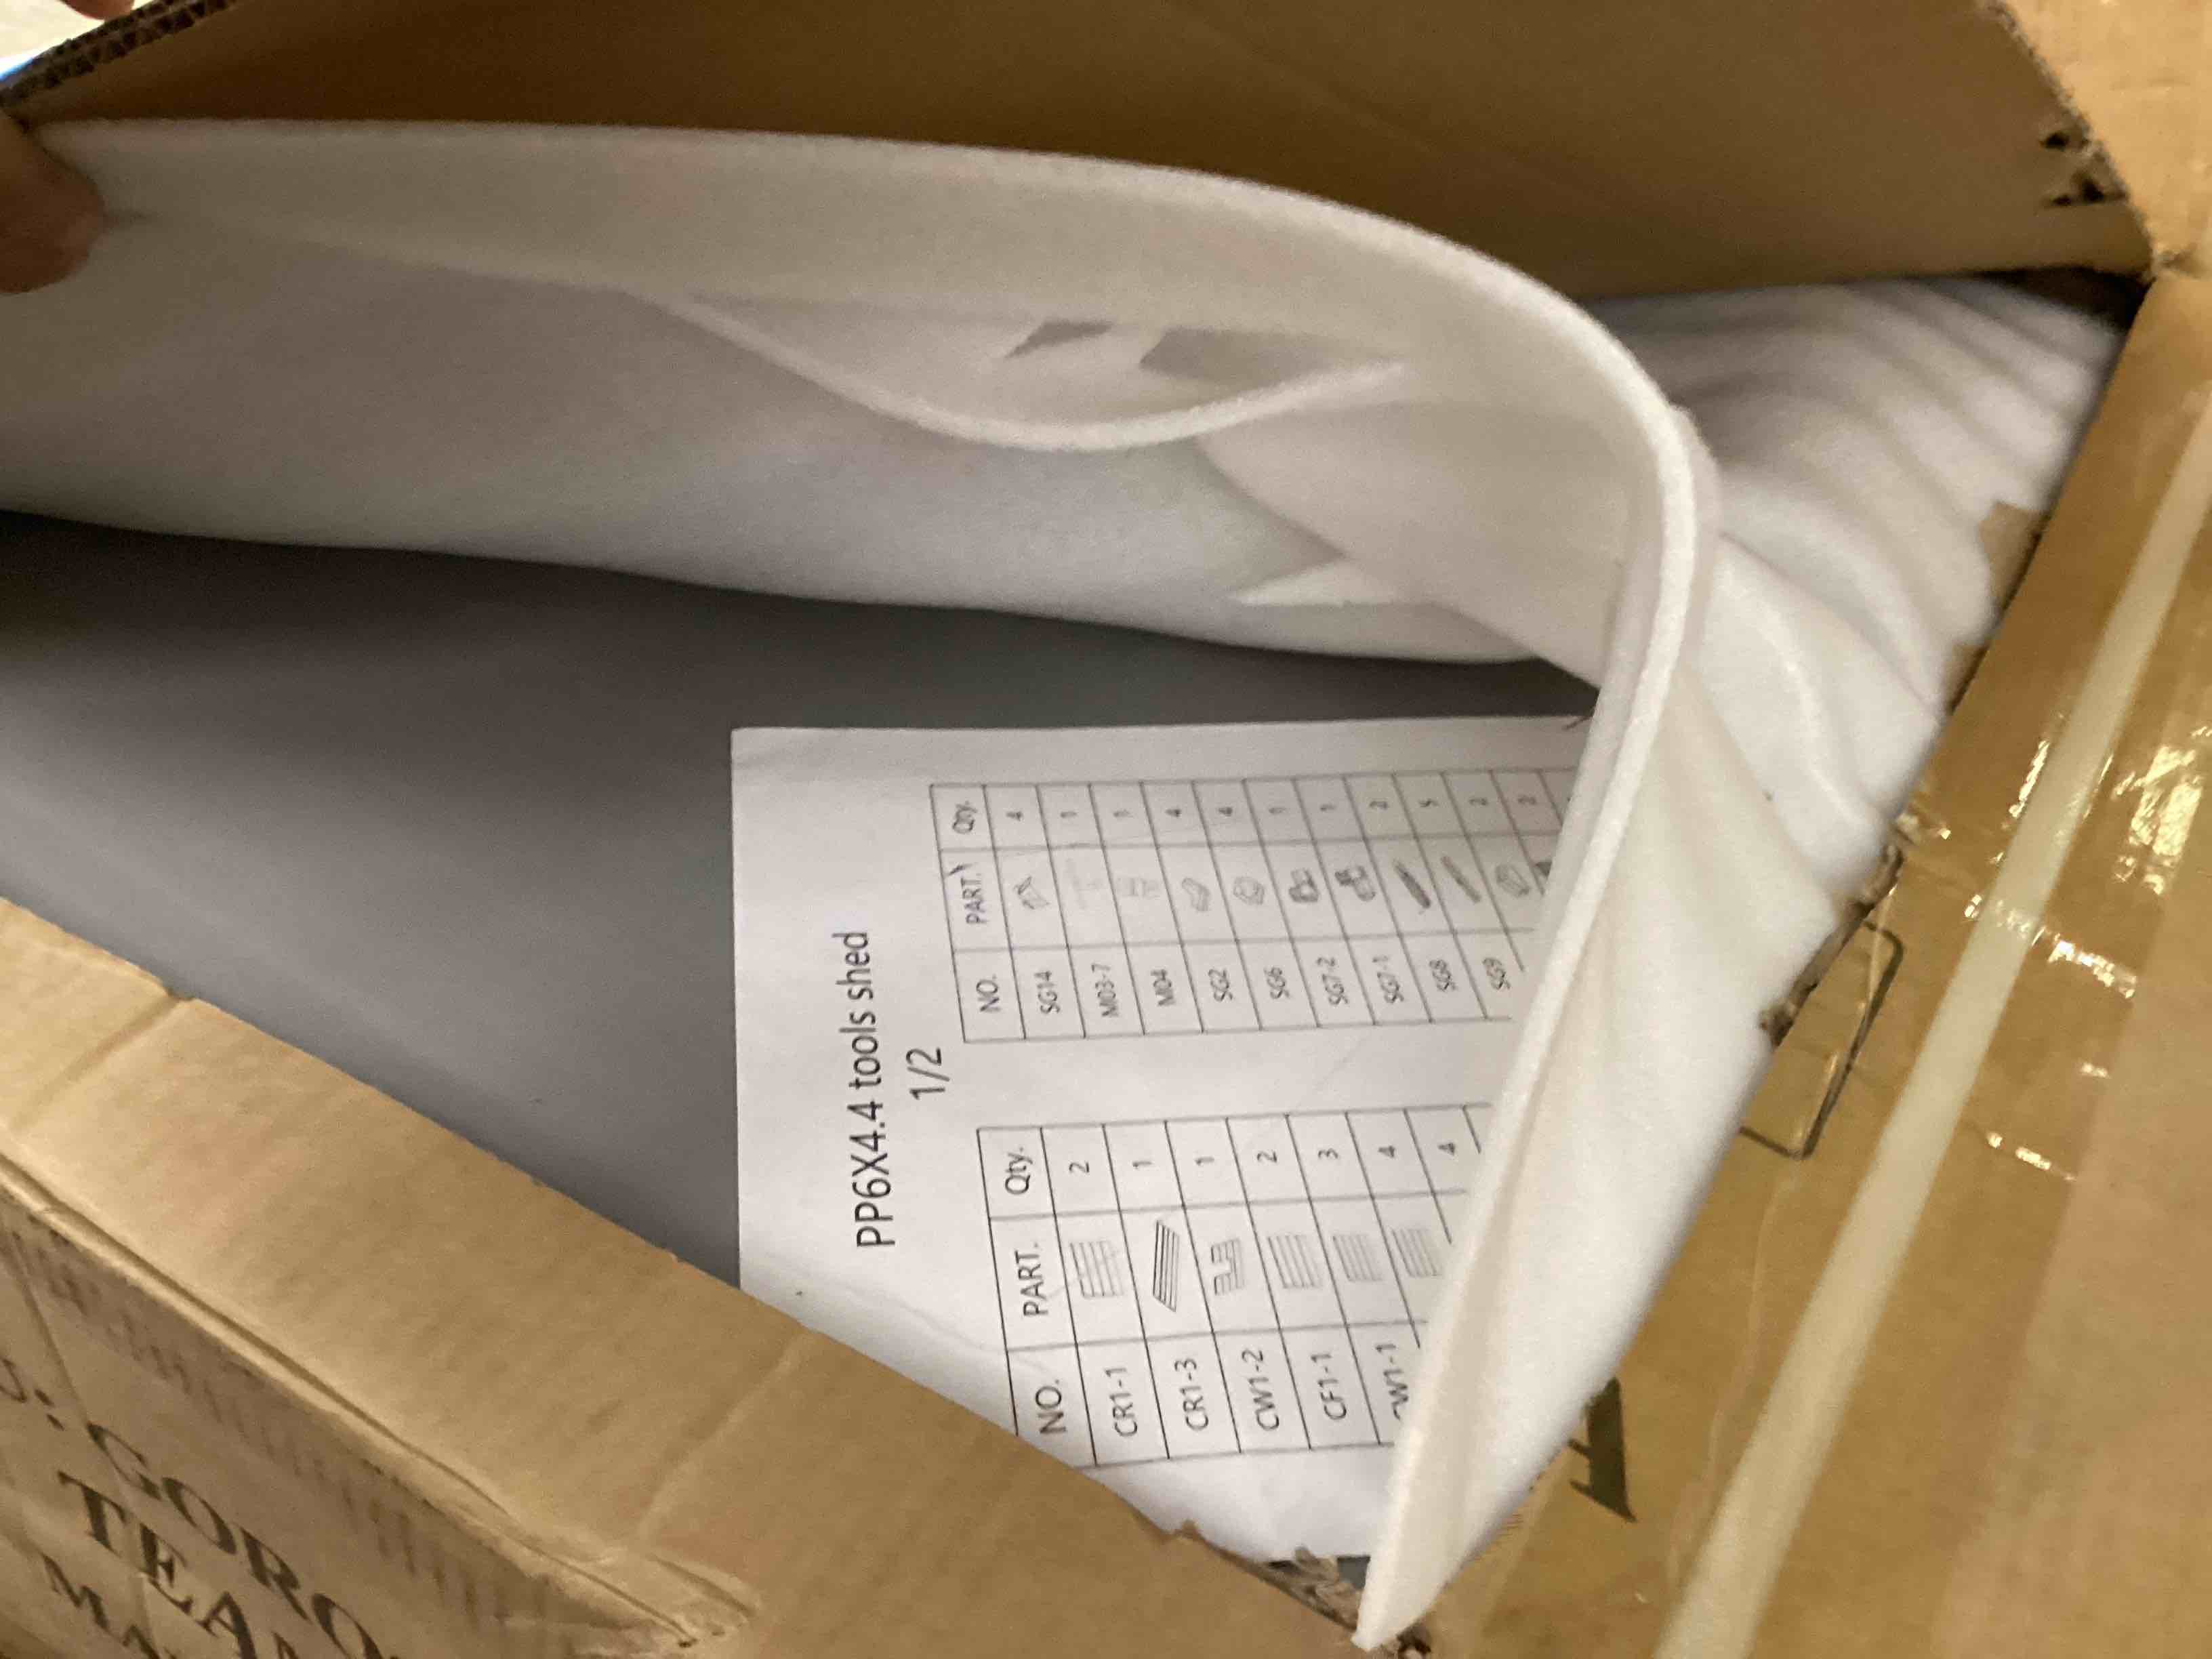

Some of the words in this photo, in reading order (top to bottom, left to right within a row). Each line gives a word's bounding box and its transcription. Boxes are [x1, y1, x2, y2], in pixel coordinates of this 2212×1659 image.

[960, 873, 988, 924] PART.
[832, 933, 874, 1000] shed
[1208, 969, 1233, 1002] SG2
[976, 977, 1000, 1012] NO.
[1035, 971, 1061, 1014] SG14
[840, 1012, 882, 1089] tools
[906, 1048, 949, 1100] 1/2
[847, 1101, 895, 1247] PP6X4.4
[1005, 1148, 1033, 1195] Qty.
[1069, 1162, 1090, 1173] 2
[1132, 1161, 1151, 1169] 1
[1195, 1157, 1214, 1166] 1
[1256, 1151, 1277, 1163] 2
[1318, 1149, 1338, 1159] 3
[1378, 1145, 1395, 1158] 4
[1438, 1143, 1456, 1155] 4
[1015, 1244, 1048, 1316] PART.
[1035, 1380, 1065, 1433] NO.
[1105, 1368, 1138, 1437] CR1-1
[1174, 1358, 1209, 1430] CR1-3
[1242, 1349, 1279, 1431] CW1-2
[1311, 1354, 1347, 1420] CF1-1
[86, 1422, 398, 1659] GORO
